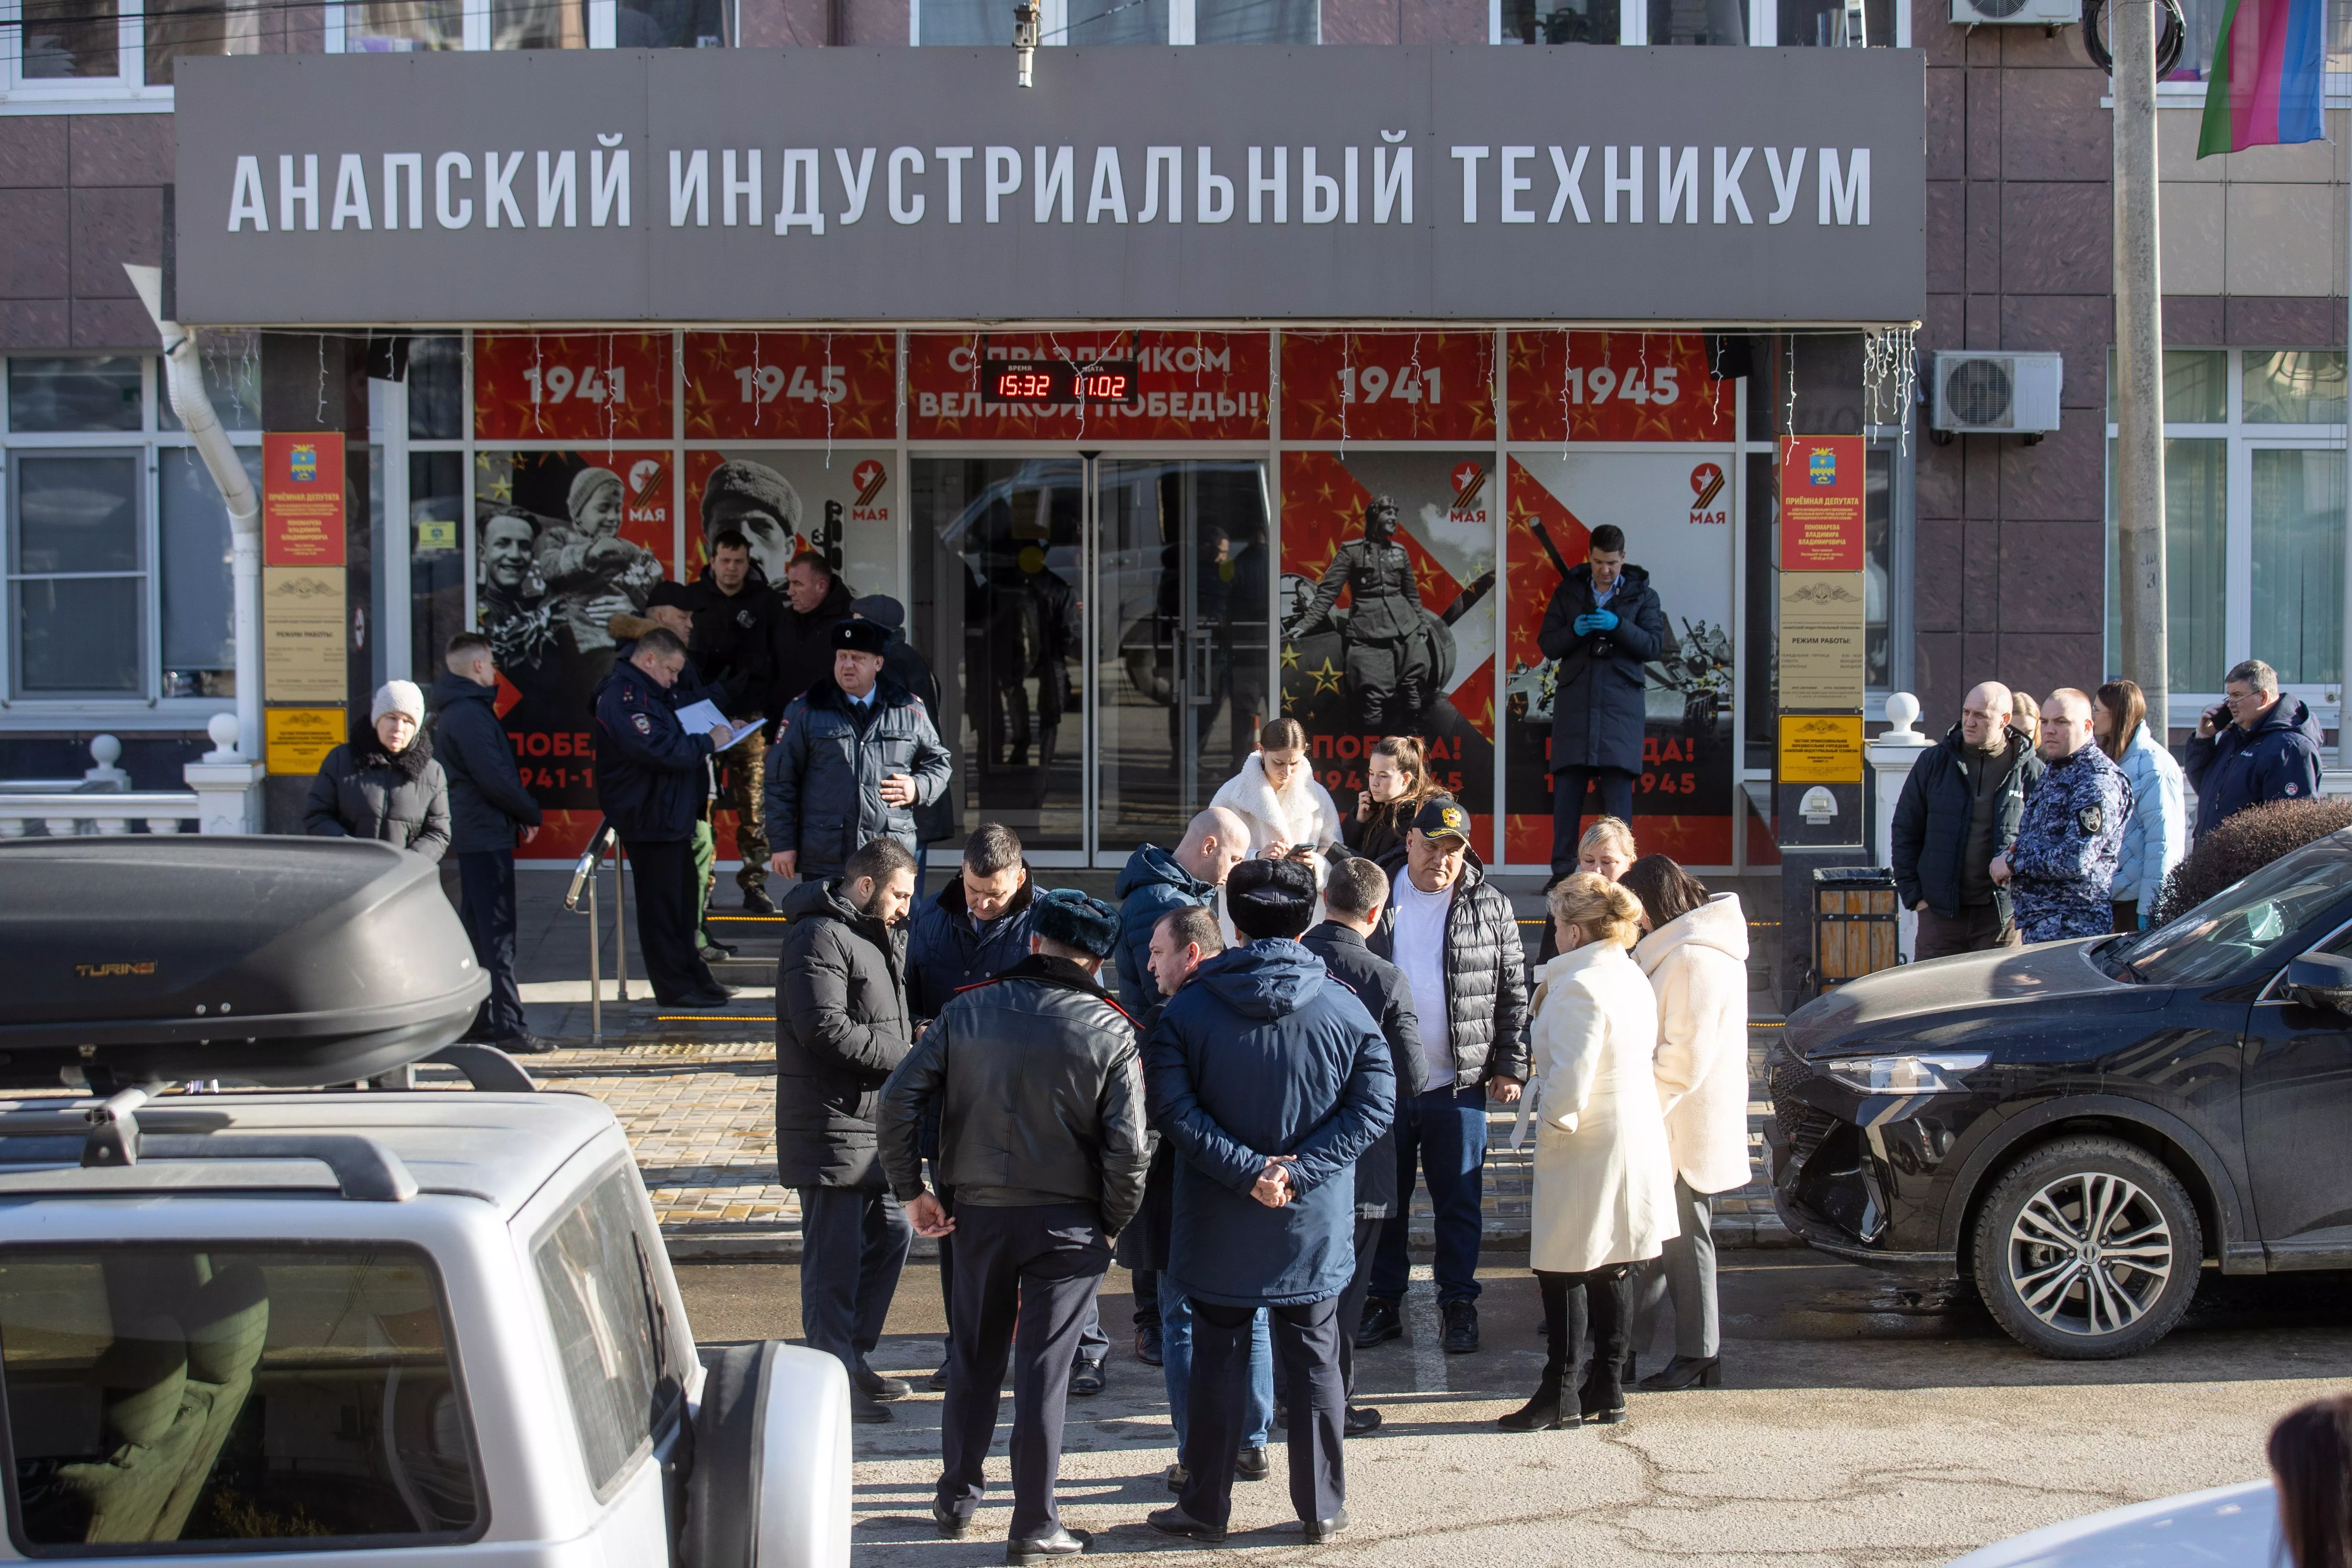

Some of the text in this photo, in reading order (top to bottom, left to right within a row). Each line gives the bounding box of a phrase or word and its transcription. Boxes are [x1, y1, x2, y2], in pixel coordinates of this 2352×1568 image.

[228, 129, 1870, 235] АНАПСКИЙ ИНДУСТРИАЛЬНЫЙ ТЕХНИКУМ
[949, 347, 972, 372] С
[523, 366, 625, 403] 1941
[735, 366, 846, 404] 1945
[999, 375, 1050, 396] 15:32
[1075, 375, 1125, 396] 11.02
[1337, 366, 1440, 404] 1941
[1567, 367, 1678, 405] 1945
[1786, 496, 1822, 505] ПРИЁМНАЯ
[629, 508, 665, 522] МАЯ
[852, 508, 888, 521] МАЯ
[1450, 511, 1486, 523] МАЯ
[1689, 512, 1726, 524] МАЯ
[507, 732, 596, 761] ПОБЕ
